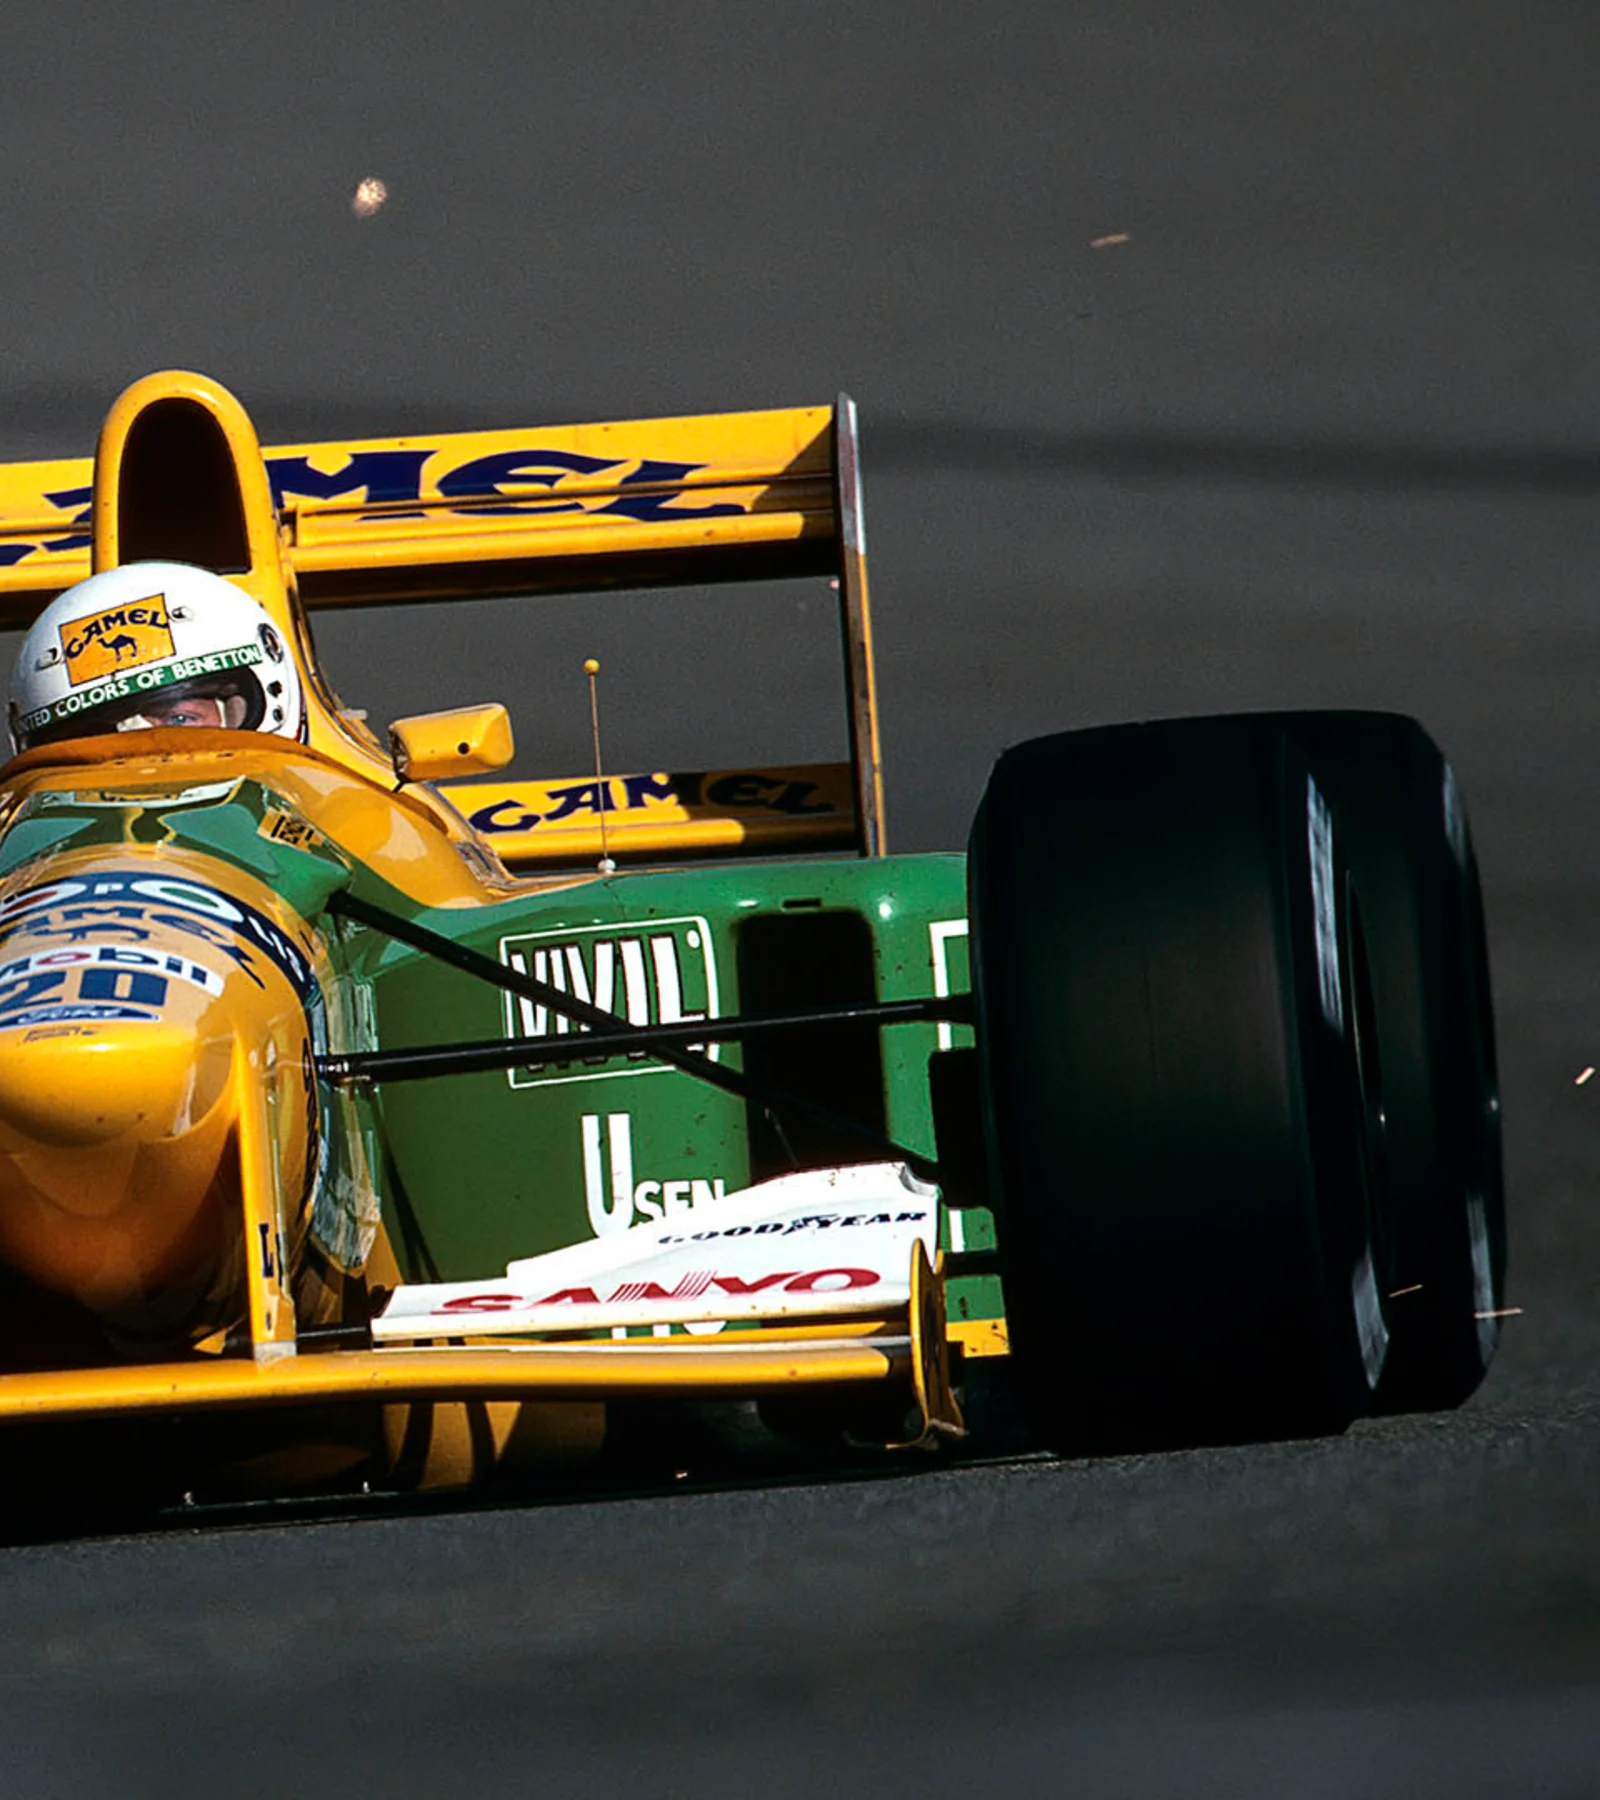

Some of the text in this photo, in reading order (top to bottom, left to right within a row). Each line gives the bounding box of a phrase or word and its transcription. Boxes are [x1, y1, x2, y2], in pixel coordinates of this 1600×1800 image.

[65, 608, 169, 658] CAMEL
[55, 679, 131, 718] COLORS
[136, 669, 166, 688] OF
[173, 647, 261, 681] BENETTON
[469, 772, 836, 833] CAMEL
[510, 933, 708, 1072] VIVIL
[432, 1268, 882, 1315] SANYO
